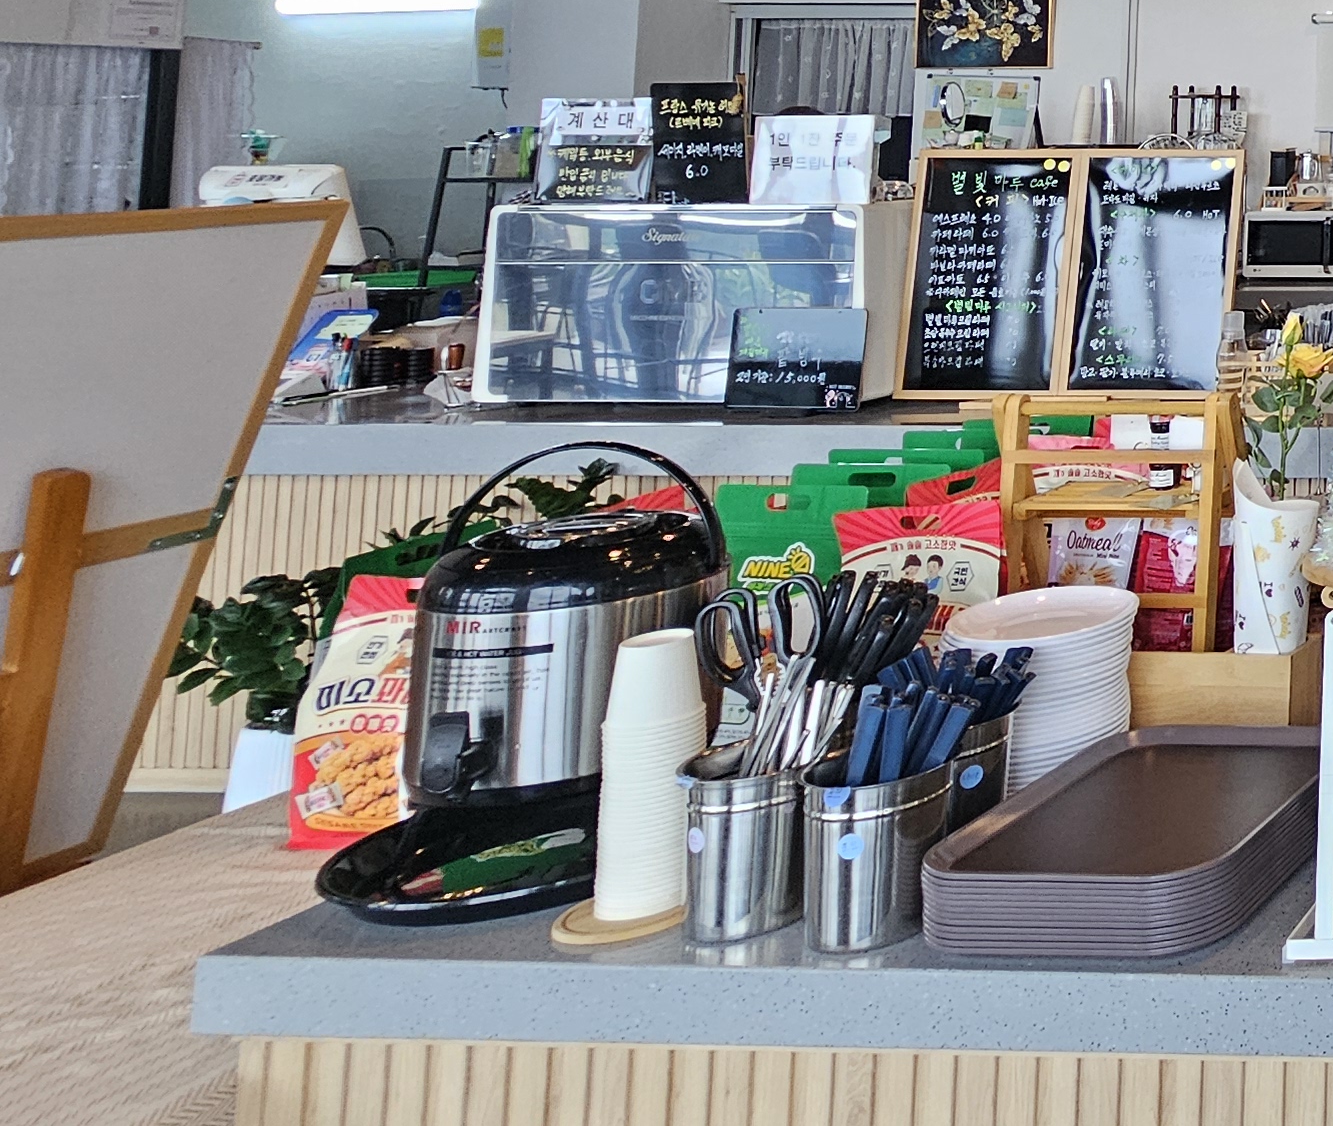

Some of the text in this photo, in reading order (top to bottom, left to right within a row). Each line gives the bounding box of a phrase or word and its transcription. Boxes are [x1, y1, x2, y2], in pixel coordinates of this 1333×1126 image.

[568, 112, 634, 129] 계산대
[685, 164, 709, 179] 6.0
[1066, 530, 1123, 552] Oatmeal
[742, 559, 793, 579] NINE
[446, 620, 482, 634] MIR
